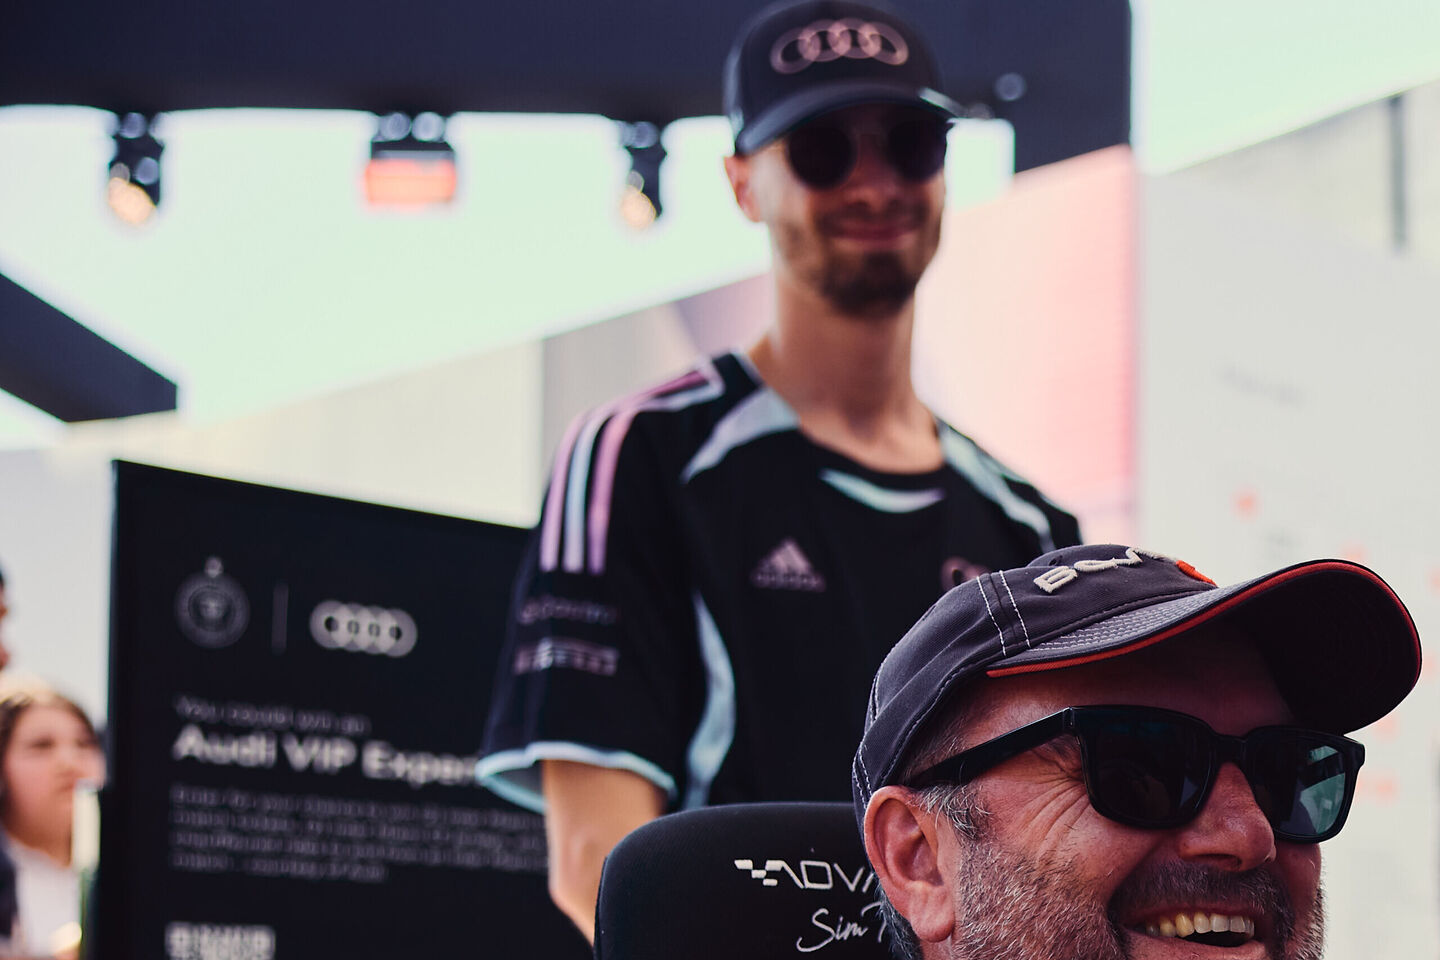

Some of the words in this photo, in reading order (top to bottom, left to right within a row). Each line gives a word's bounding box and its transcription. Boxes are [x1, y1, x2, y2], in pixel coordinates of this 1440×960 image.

[173, 726, 275, 767] Audi
[284, 735, 356, 772] VIP
[796, 907, 869, 952] Sim
